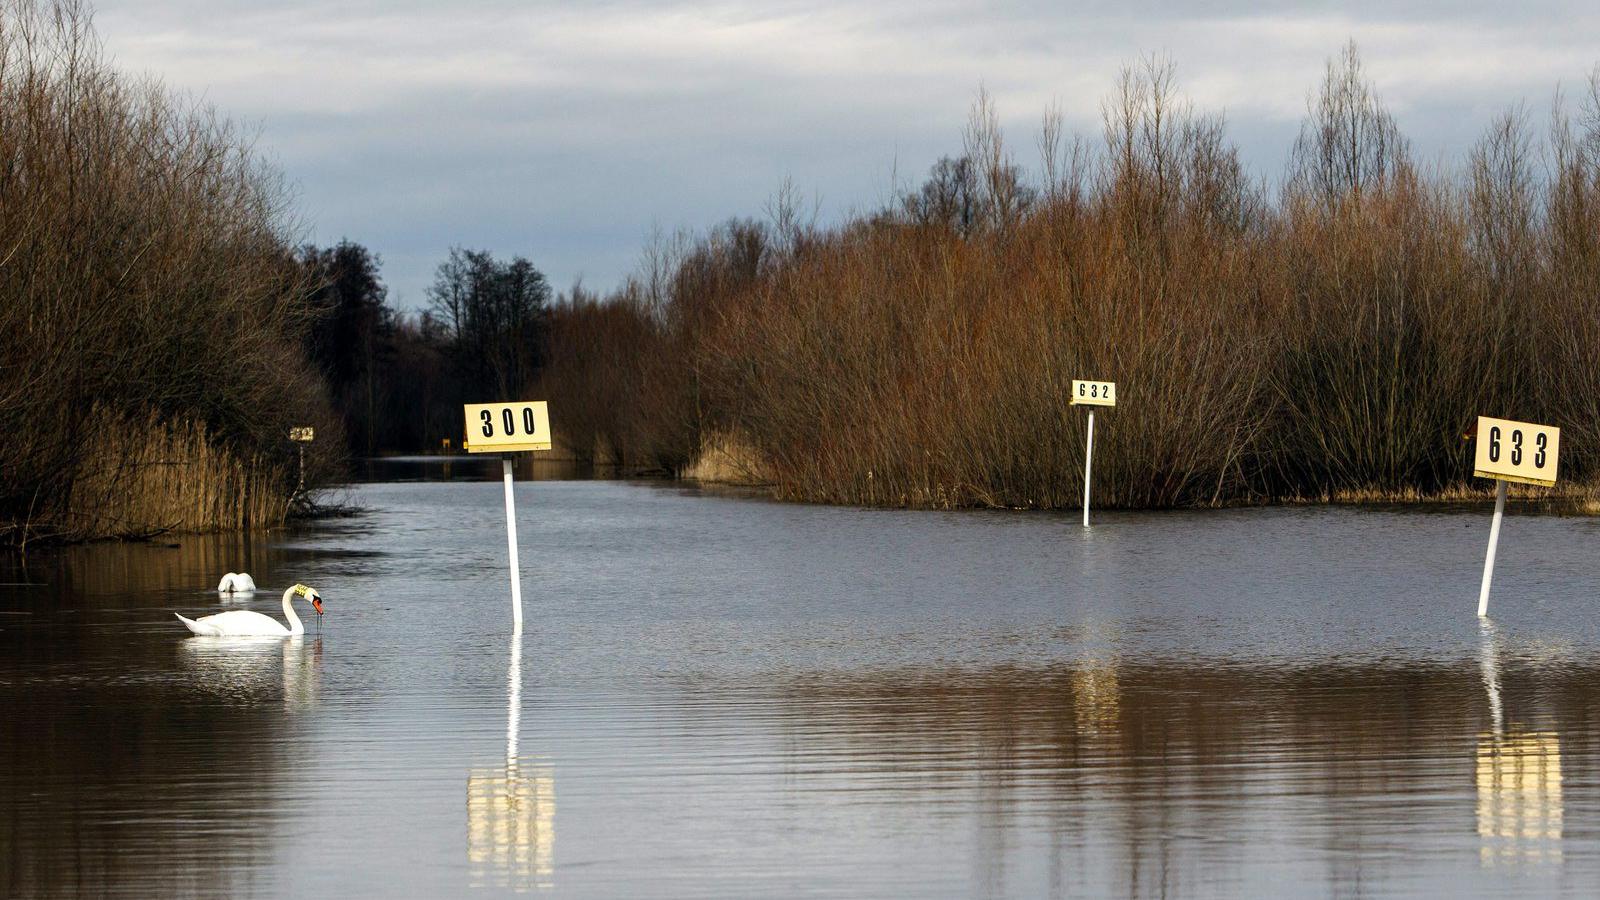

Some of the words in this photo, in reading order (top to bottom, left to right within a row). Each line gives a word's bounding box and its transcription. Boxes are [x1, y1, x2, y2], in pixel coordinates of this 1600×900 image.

[1080, 383, 1108, 399] 632
[480, 407, 535, 438] 300
[1489, 426, 1547, 469] 633
